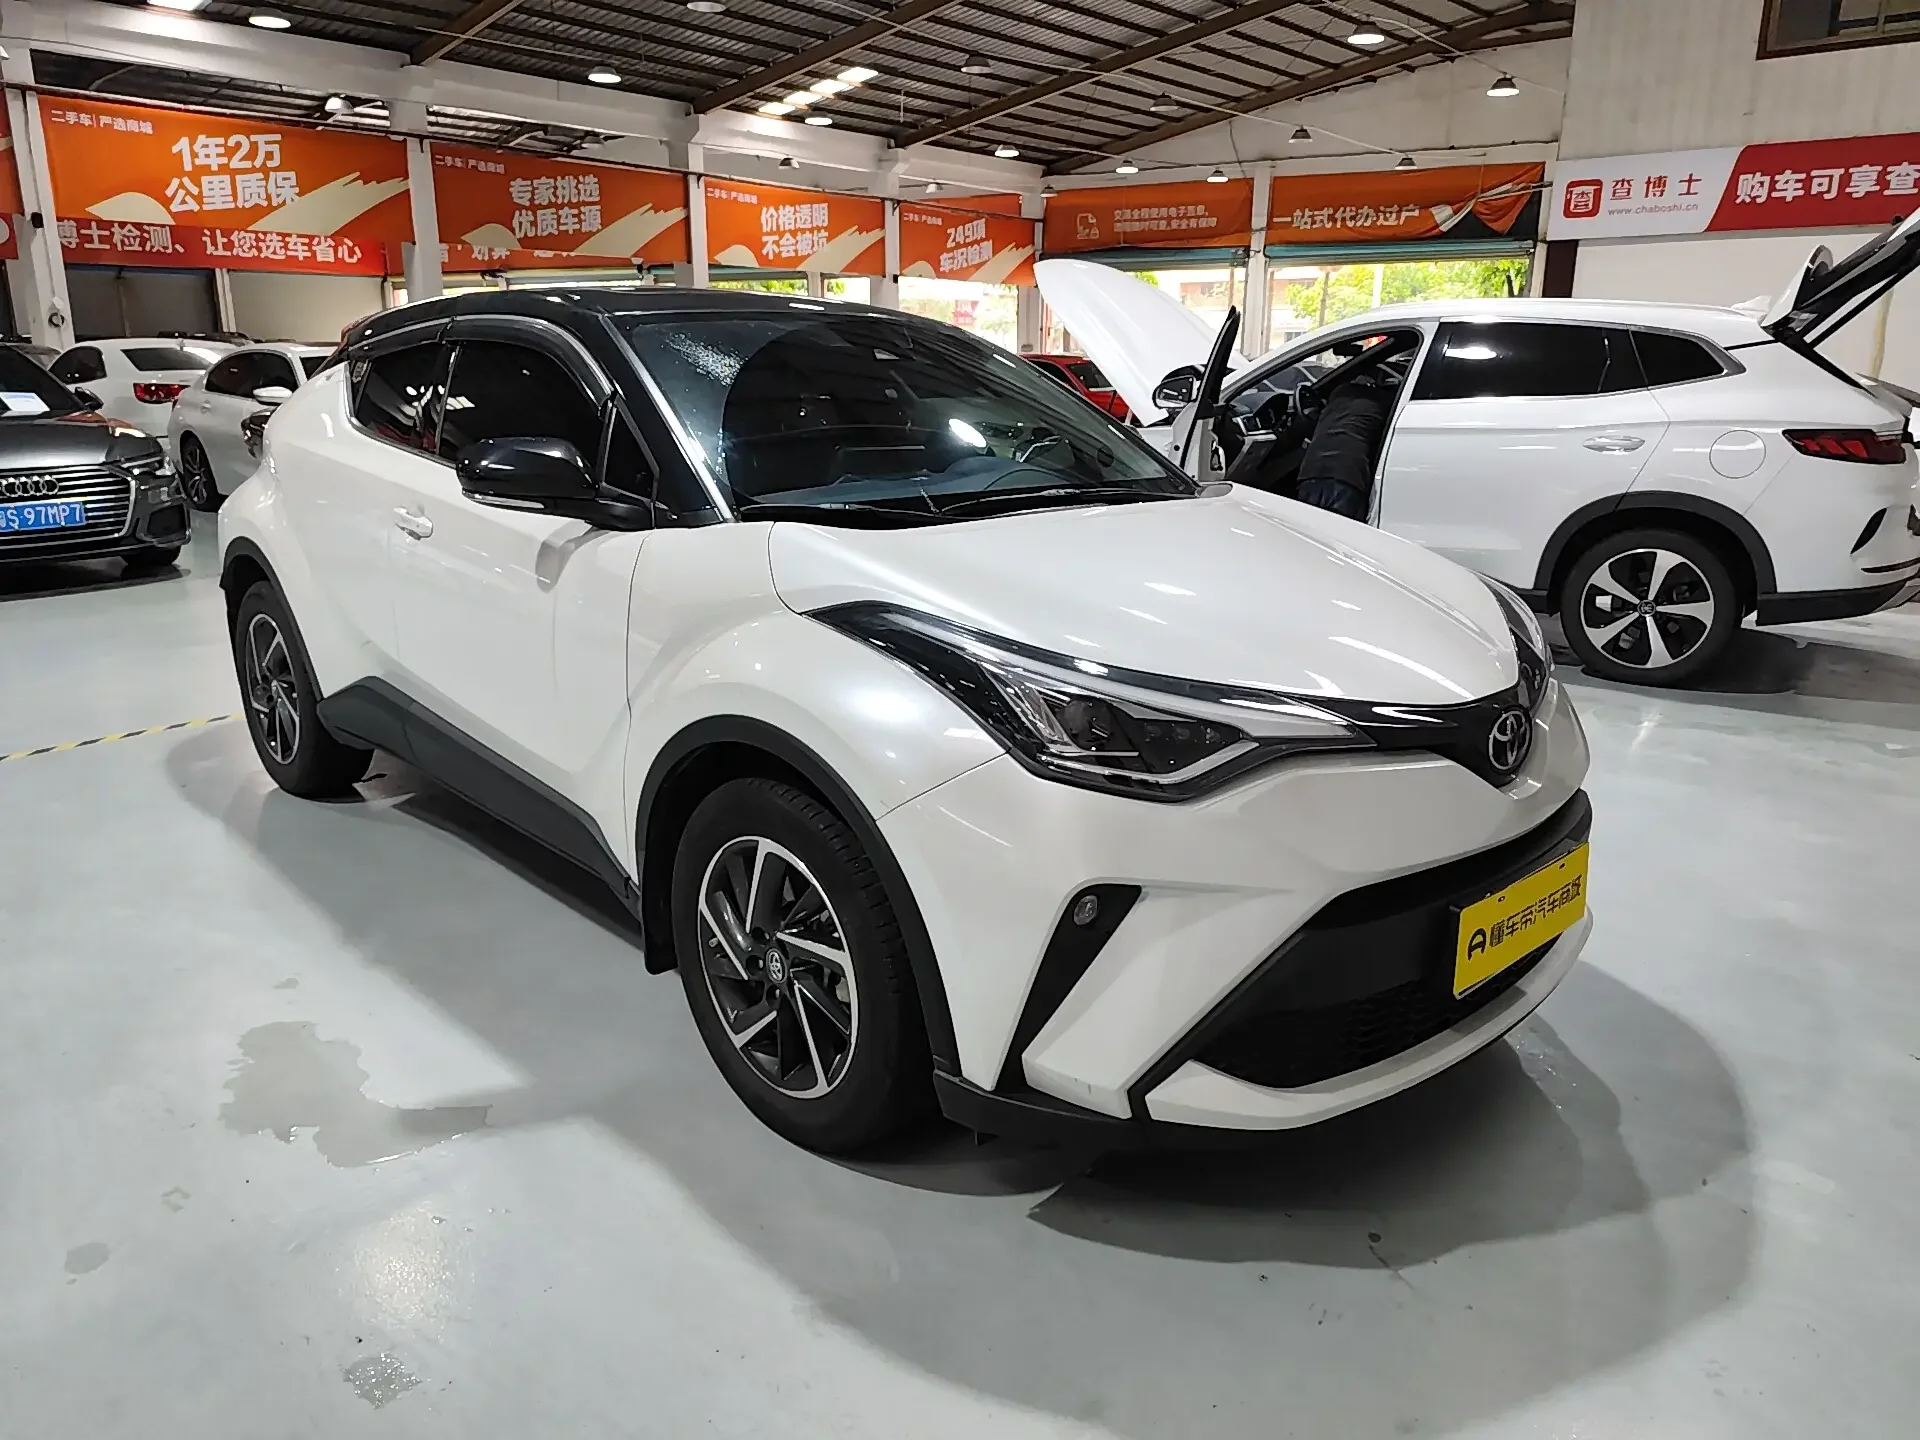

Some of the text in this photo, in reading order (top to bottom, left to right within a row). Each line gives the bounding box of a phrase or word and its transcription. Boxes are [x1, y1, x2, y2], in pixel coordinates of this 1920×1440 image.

[51, 110, 93, 126] 二手车
[171, 134, 283, 171] 1年2万
[165, 171, 300, 213] 公里质保
[509, 174, 600, 206] 专家挑选
[1610, 173, 1703, 201] 查博士
[1734, 161, 1920, 204] 购车可享查
[512, 205, 602, 238] 优质车源
[761, 203, 829, 233] 价格透明
[1273, 204, 1421, 230] 一站式代办过户
[1608, 203, 1699, 216] www.chaboshi.cn
[761, 229, 829, 260] 不会被坑
